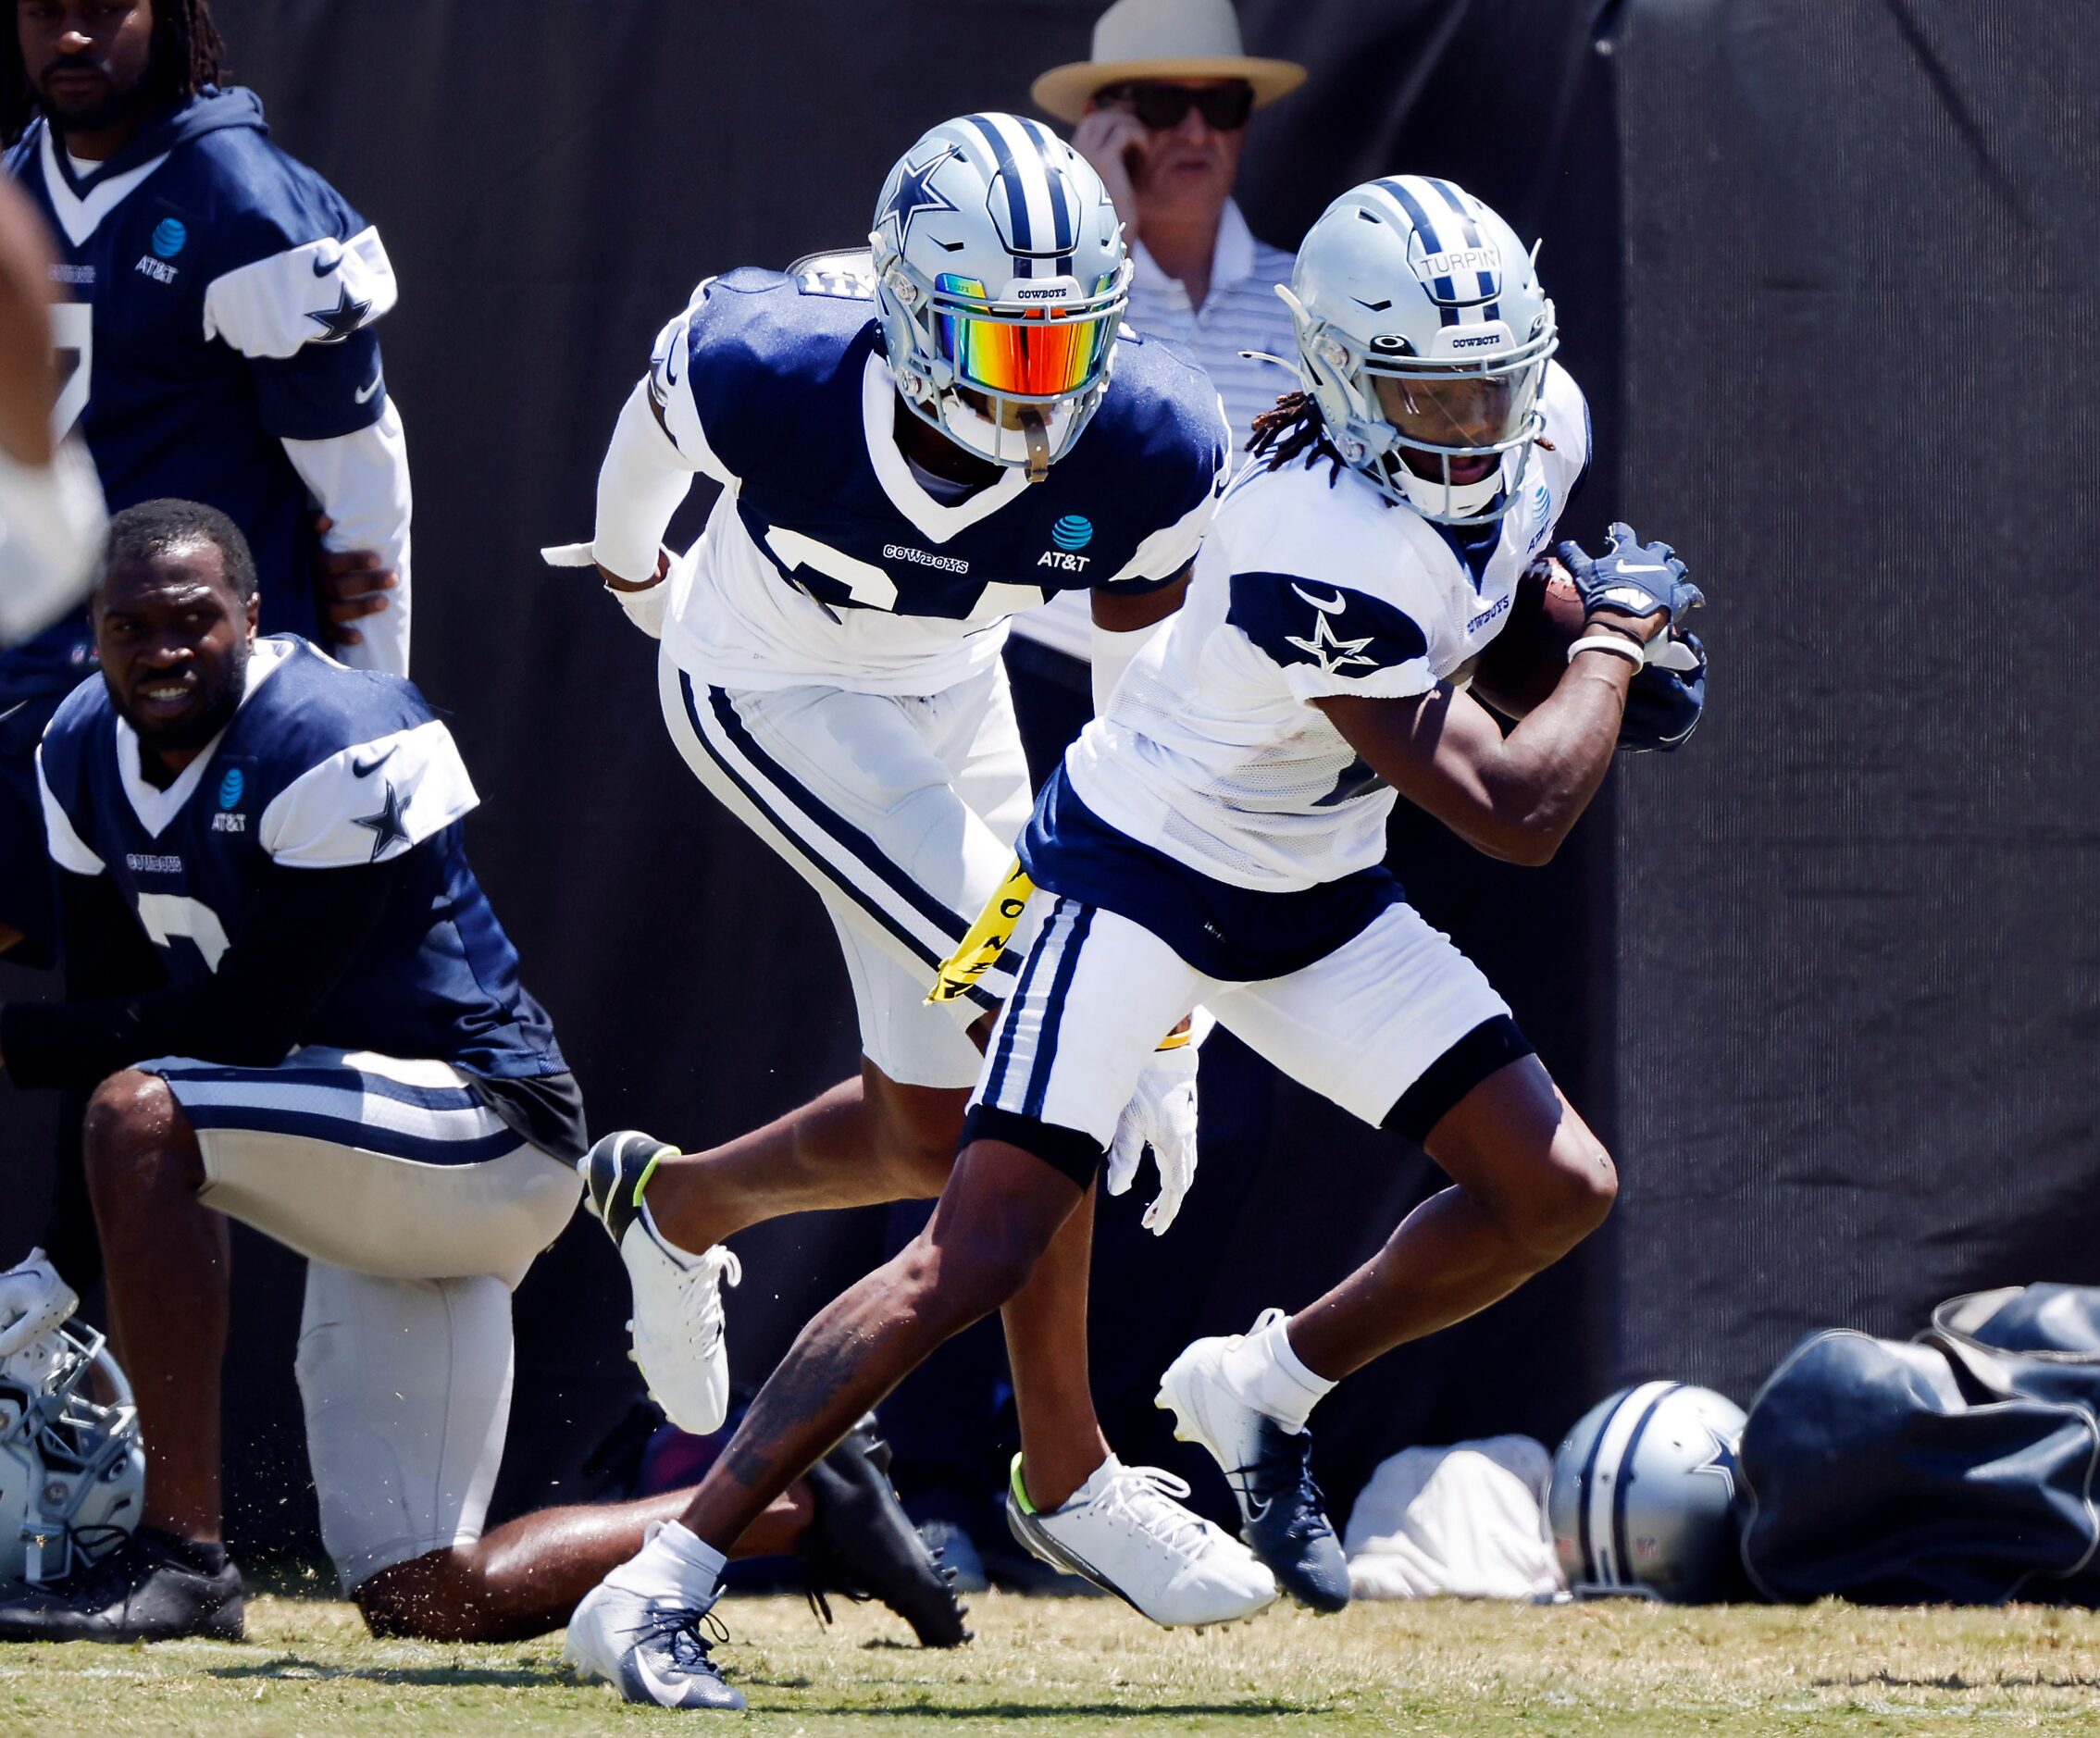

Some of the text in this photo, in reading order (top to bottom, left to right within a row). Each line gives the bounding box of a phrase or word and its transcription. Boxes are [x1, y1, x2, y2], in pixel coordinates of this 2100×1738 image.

[135, 254, 179, 284] AT&T
[1420, 249, 1497, 276] TURPIN
[1018, 288, 1067, 299] COWBOYS
[1453, 334, 1500, 348] COWBOYS
[883, 544, 969, 574] COWBOYS
[1037, 551, 1090, 572] AT&T
[211, 813, 246, 832] AT&T
